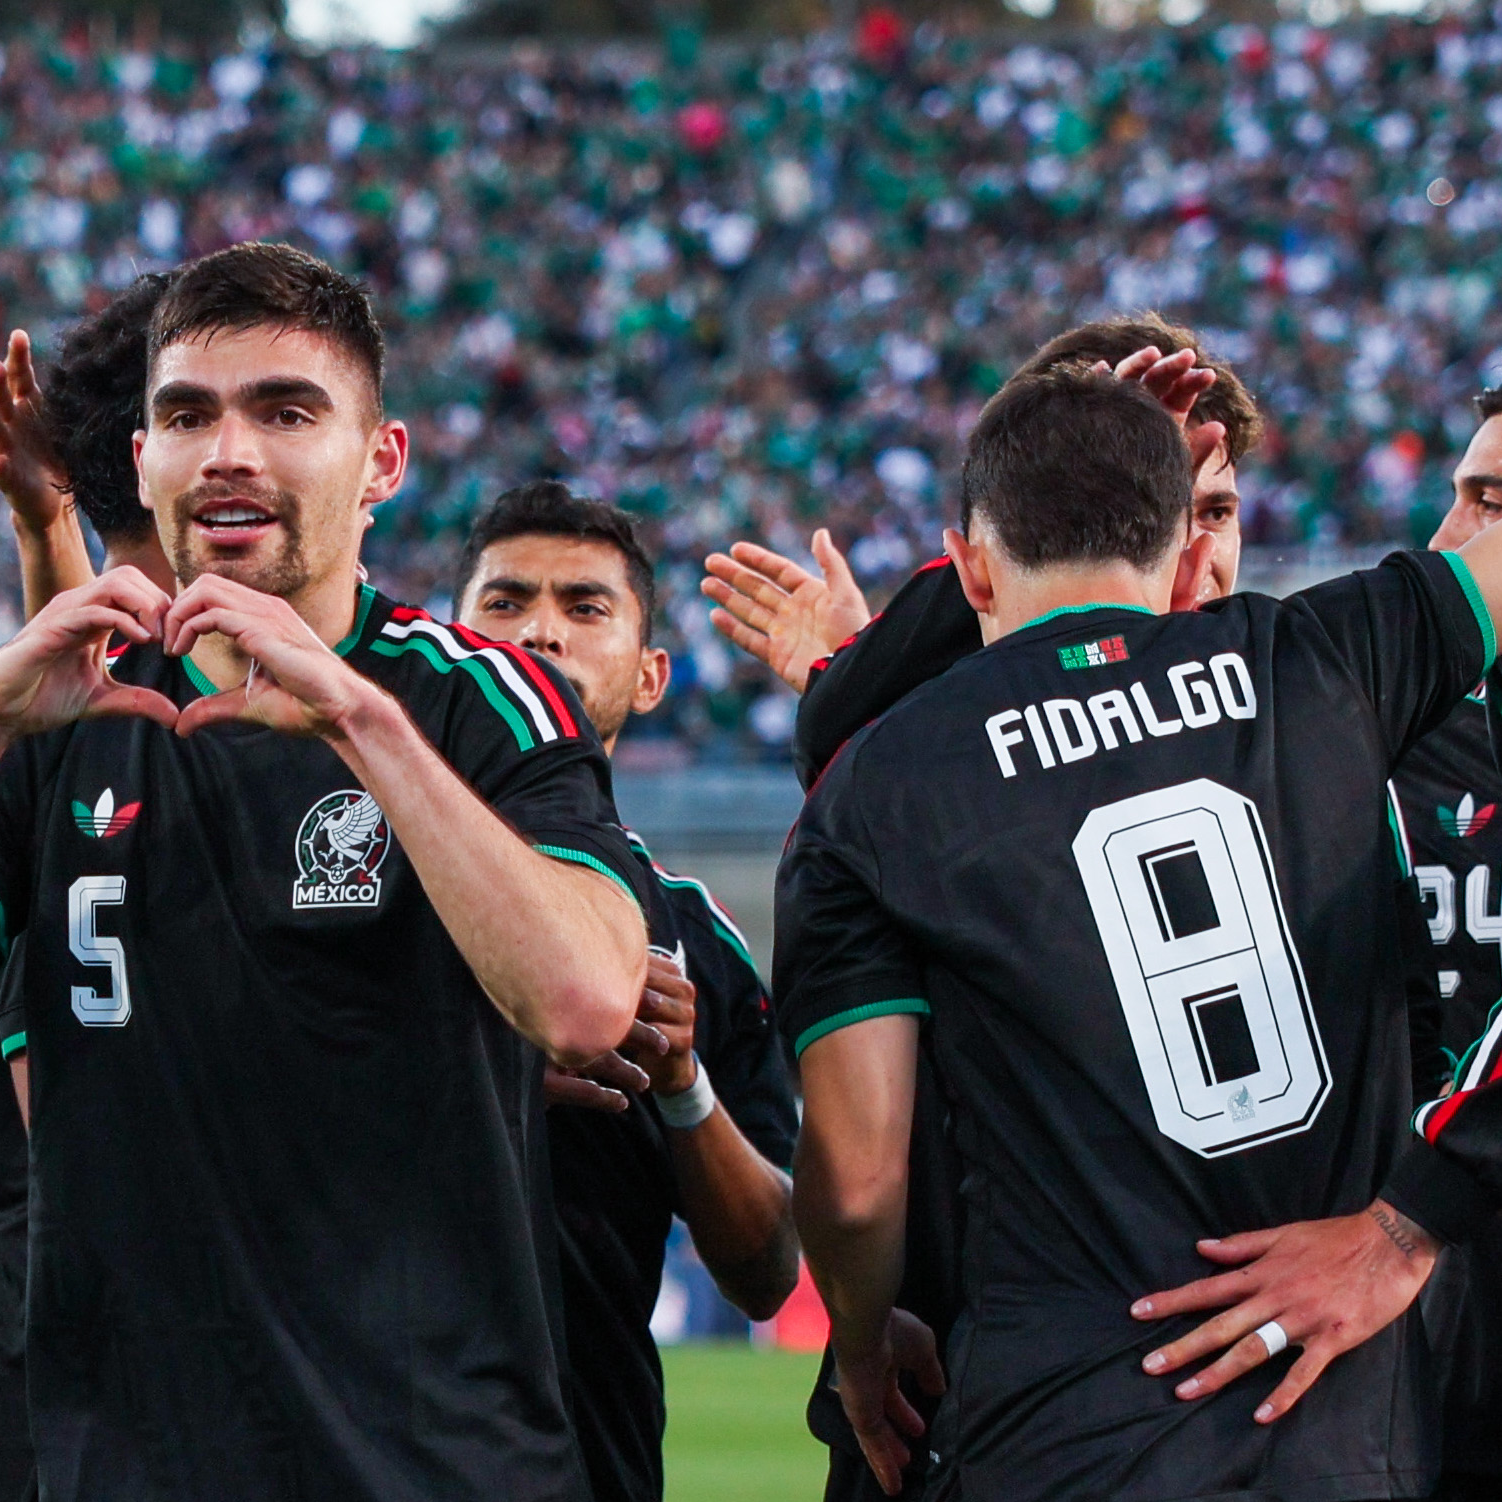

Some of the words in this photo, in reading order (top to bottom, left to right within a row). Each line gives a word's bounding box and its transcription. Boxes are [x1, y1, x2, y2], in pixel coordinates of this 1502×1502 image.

[984, 652, 1257, 778] FIDALGO
[67, 874, 132, 1028] 5
[297, 881, 375, 904] MÉXICO
[1071, 778, 1334, 1160] 8
